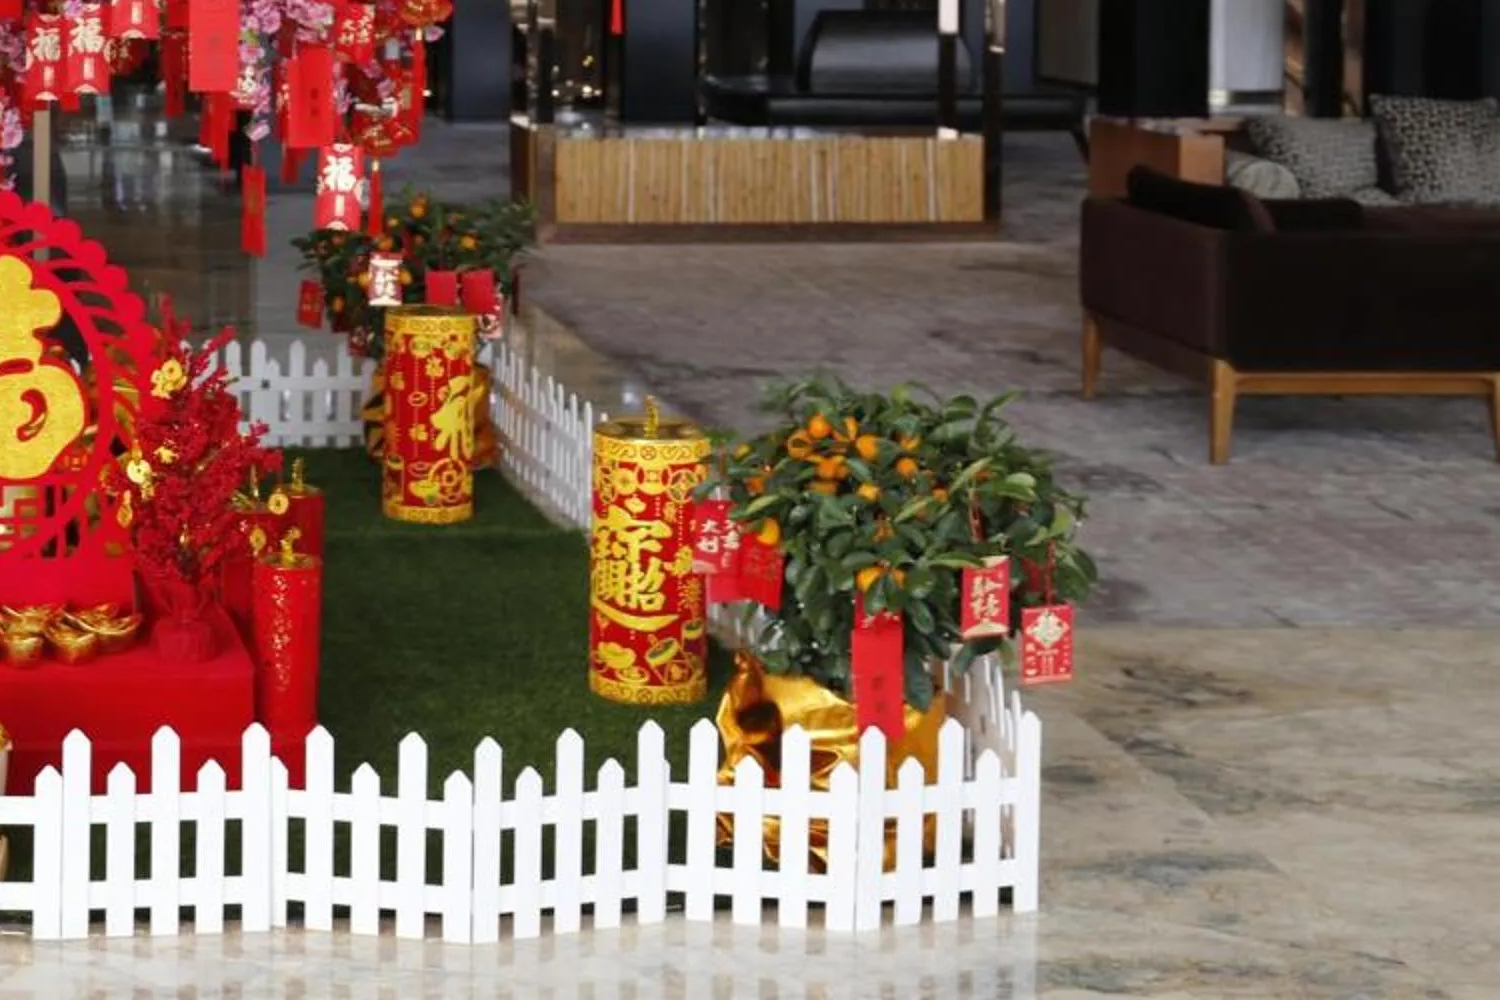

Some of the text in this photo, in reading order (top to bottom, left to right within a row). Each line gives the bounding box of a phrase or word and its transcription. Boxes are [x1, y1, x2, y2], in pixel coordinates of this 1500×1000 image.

[32, 27, 61, 61] 福
[69, 17, 105, 54] 福
[323, 156, 357, 192] 福
